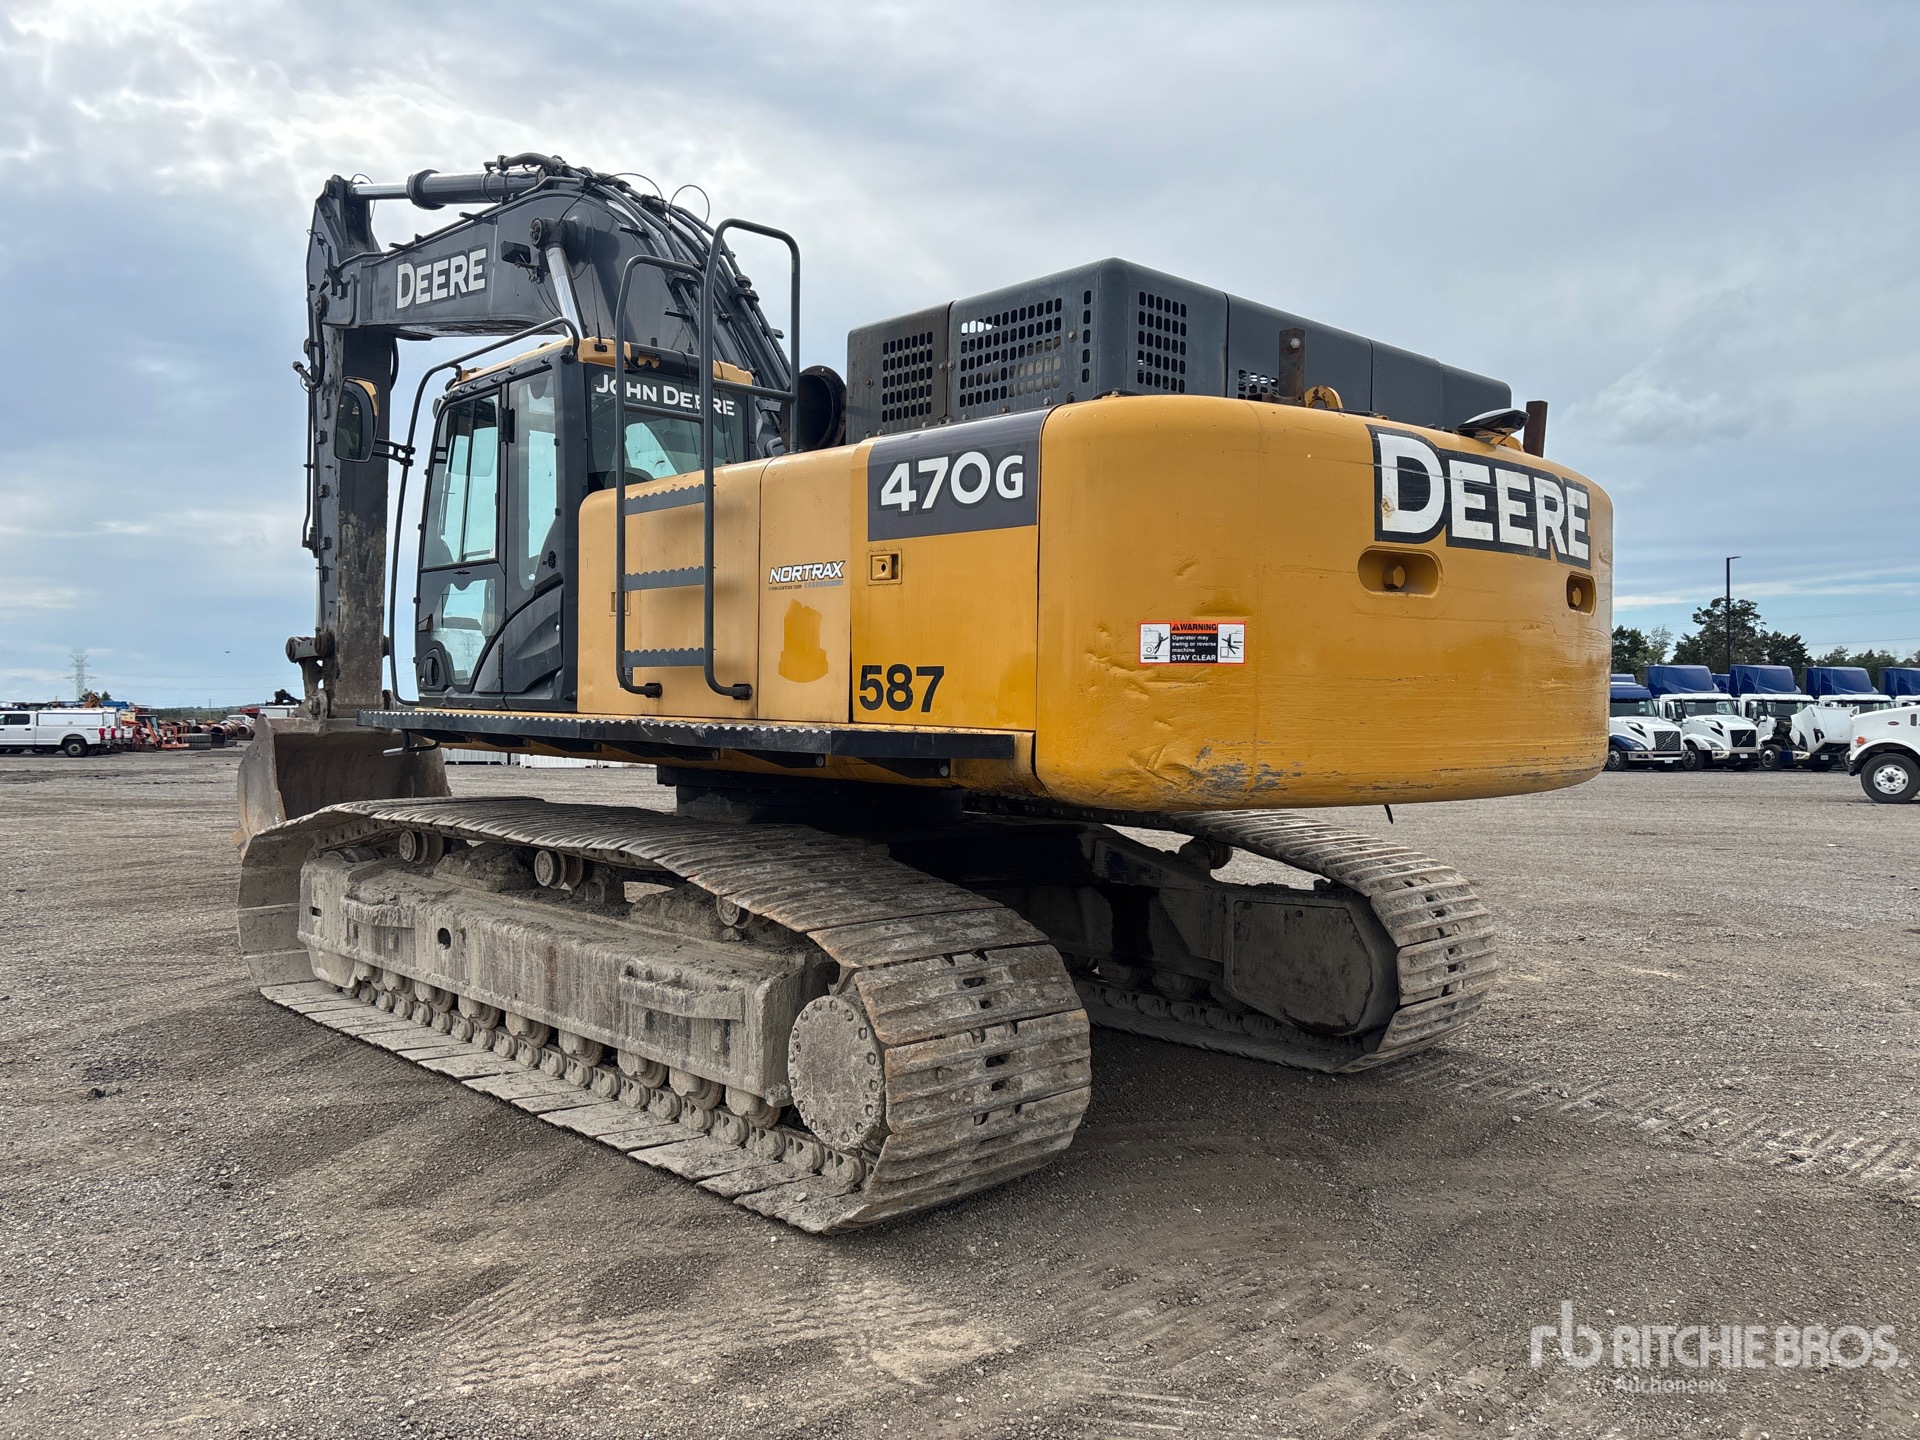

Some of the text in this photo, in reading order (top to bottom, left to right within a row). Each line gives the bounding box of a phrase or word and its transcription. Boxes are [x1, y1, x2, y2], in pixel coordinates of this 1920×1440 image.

[397, 248, 486, 309] DEERE
[880, 451, 1024, 512] 470G
[1377, 433, 1588, 560] DEERE
[769, 560, 845, 584] NORTRAX
[1180, 623, 1217, 631] WARNING
[859, 664, 944, 712] 587
